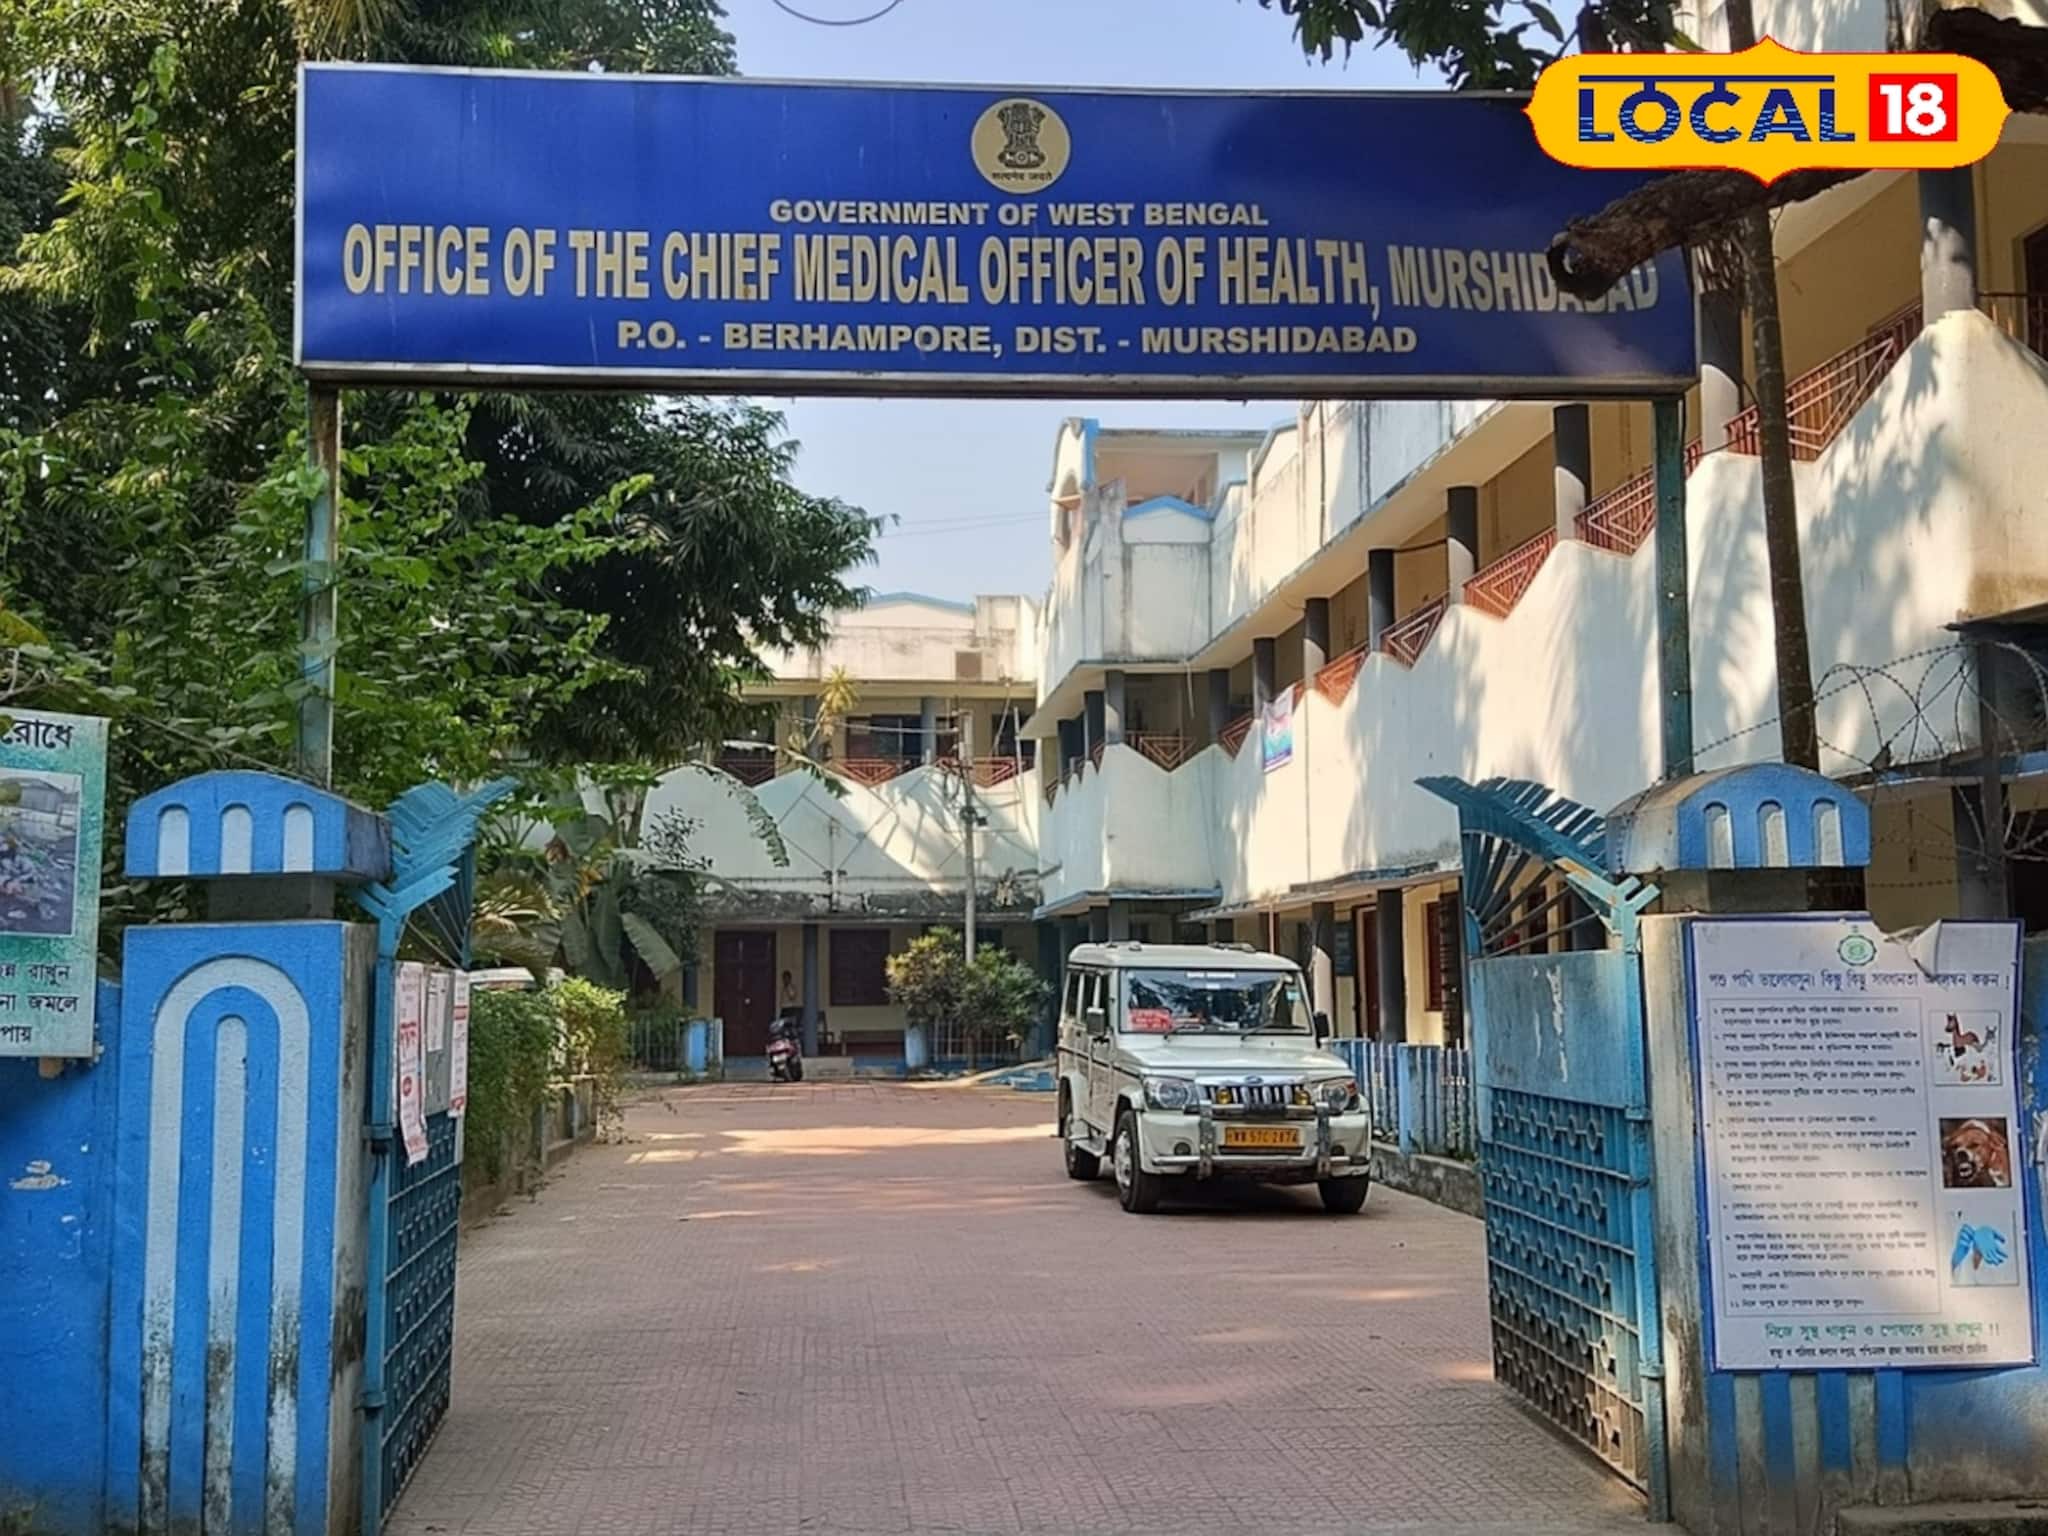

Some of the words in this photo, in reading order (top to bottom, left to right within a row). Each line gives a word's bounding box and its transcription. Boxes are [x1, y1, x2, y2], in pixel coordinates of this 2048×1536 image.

[769, 201, 989, 225] GOVERNMENT
[998, 204, 1038, 226] OF
[1048, 204, 1134, 226] WEST
[1145, 204, 1269, 227] BENGAL
[343, 223, 490, 296] OFFICE
[503, 227, 556, 297] OF
[568, 230, 650, 298] THE
[662, 231, 781, 301] CHIEF
[793, 234, 969, 304] MEDICAL
[979, 236, 1145, 306] OFFICER
[1156, 236, 1206, 305] OF
[1218, 238, 1380, 320] HEALTH,
[1388, 244, 1660, 314] MURSHIDAD
[617, 320, 687, 350] P.O.
[723, 323, 1003, 357] BERHAMPORE,
[1015, 326, 1107, 354] DIST.
[1141, 326, 1418, 354] MURSHIDABAD
